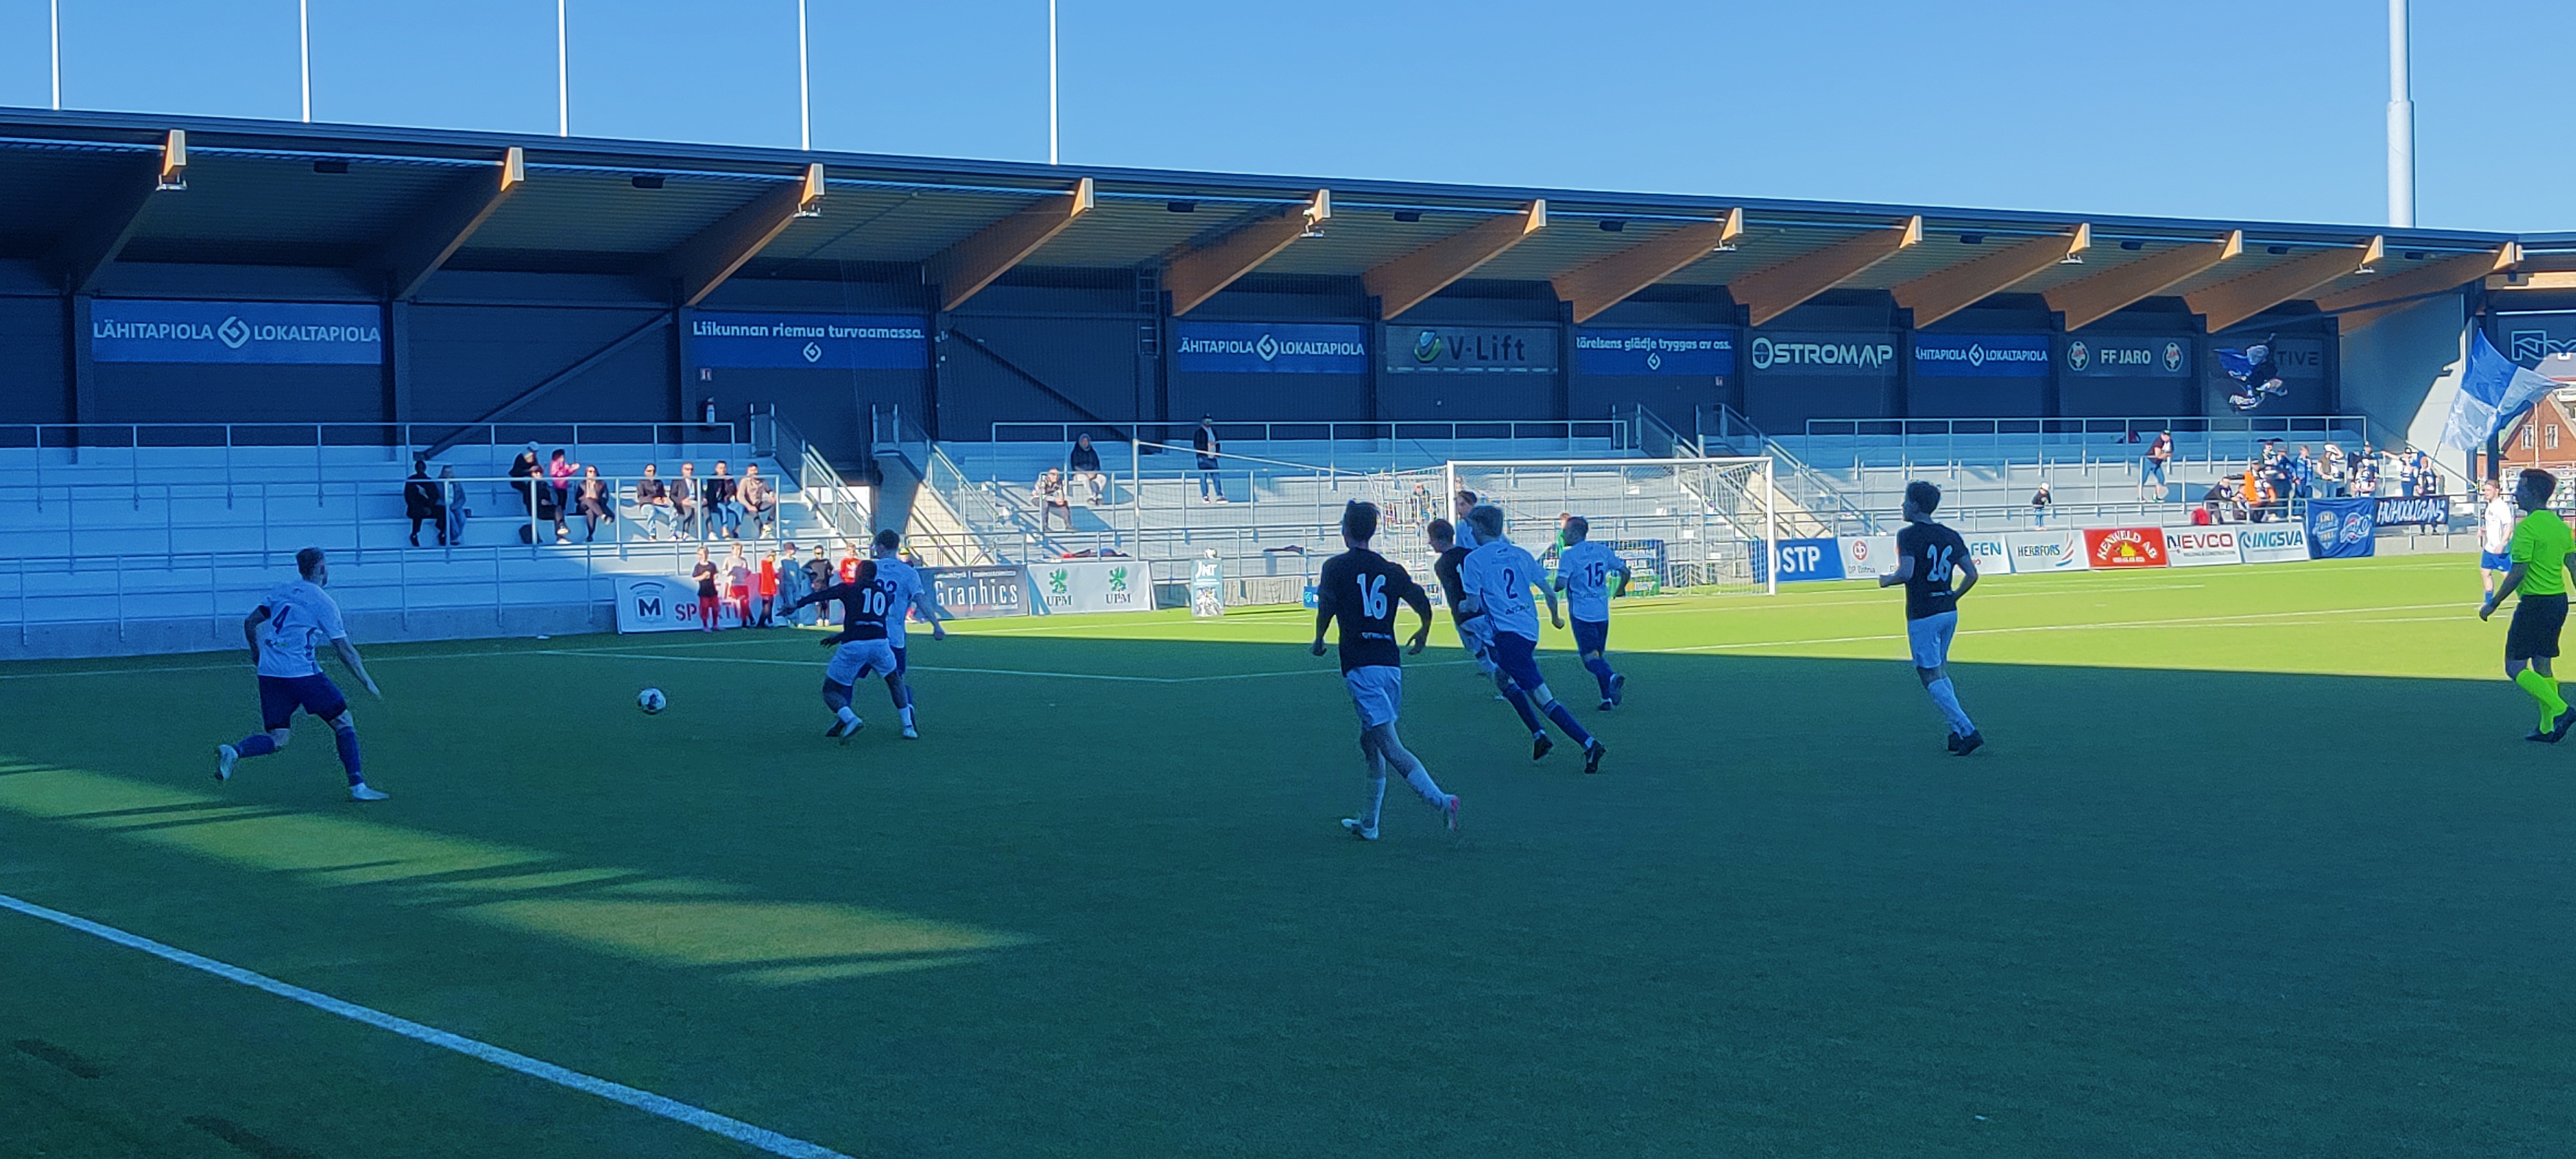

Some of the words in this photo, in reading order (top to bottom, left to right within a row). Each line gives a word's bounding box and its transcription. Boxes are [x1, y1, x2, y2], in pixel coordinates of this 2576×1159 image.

[93, 319, 214, 340] LÄHITAPIOLA
[254, 325, 381, 343] LOKALTAPIOLA
[693, 322, 769, 337] Liikunnan
[773, 323, 824, 337] riemua
[828, 325, 925, 339] turvaamassa.
[1177, 337, 1254, 354] ÄHITAPIOLA
[1281, 342, 1365, 356] LOKALTAPIOLA
[1624, 337, 1657, 352] glädje
[1659, 338, 1697, 352] tryggas
[1699, 341, 1712, 349] av
[1714, 341, 1732, 349] oss.
[1986, 350, 2047, 362] LOKALTAPIOLA
[2101, 350, 2117, 364] FF
[2119, 350, 2151, 364] JARO
[2277, 351, 2318, 366] TIVE
[2097, 531, 2141, 560] KENWELD
[2143, 541, 2157, 559] AB
[2166, 533, 2234, 549] NEVCO
[1927, 543, 1953, 581] 26
[1504, 569, 1518, 599] 2
[1584, 562, 1604, 587] 15
[861, 587, 886, 617] 10
[935, 578, 1018, 612] Graphics
[1046, 595, 1072, 607] UPM
[1106, 593, 1132, 604] UPM
[1357, 573, 1388, 620] 16
[638, 598, 661, 617] M
[272, 605, 291, 635] 4
